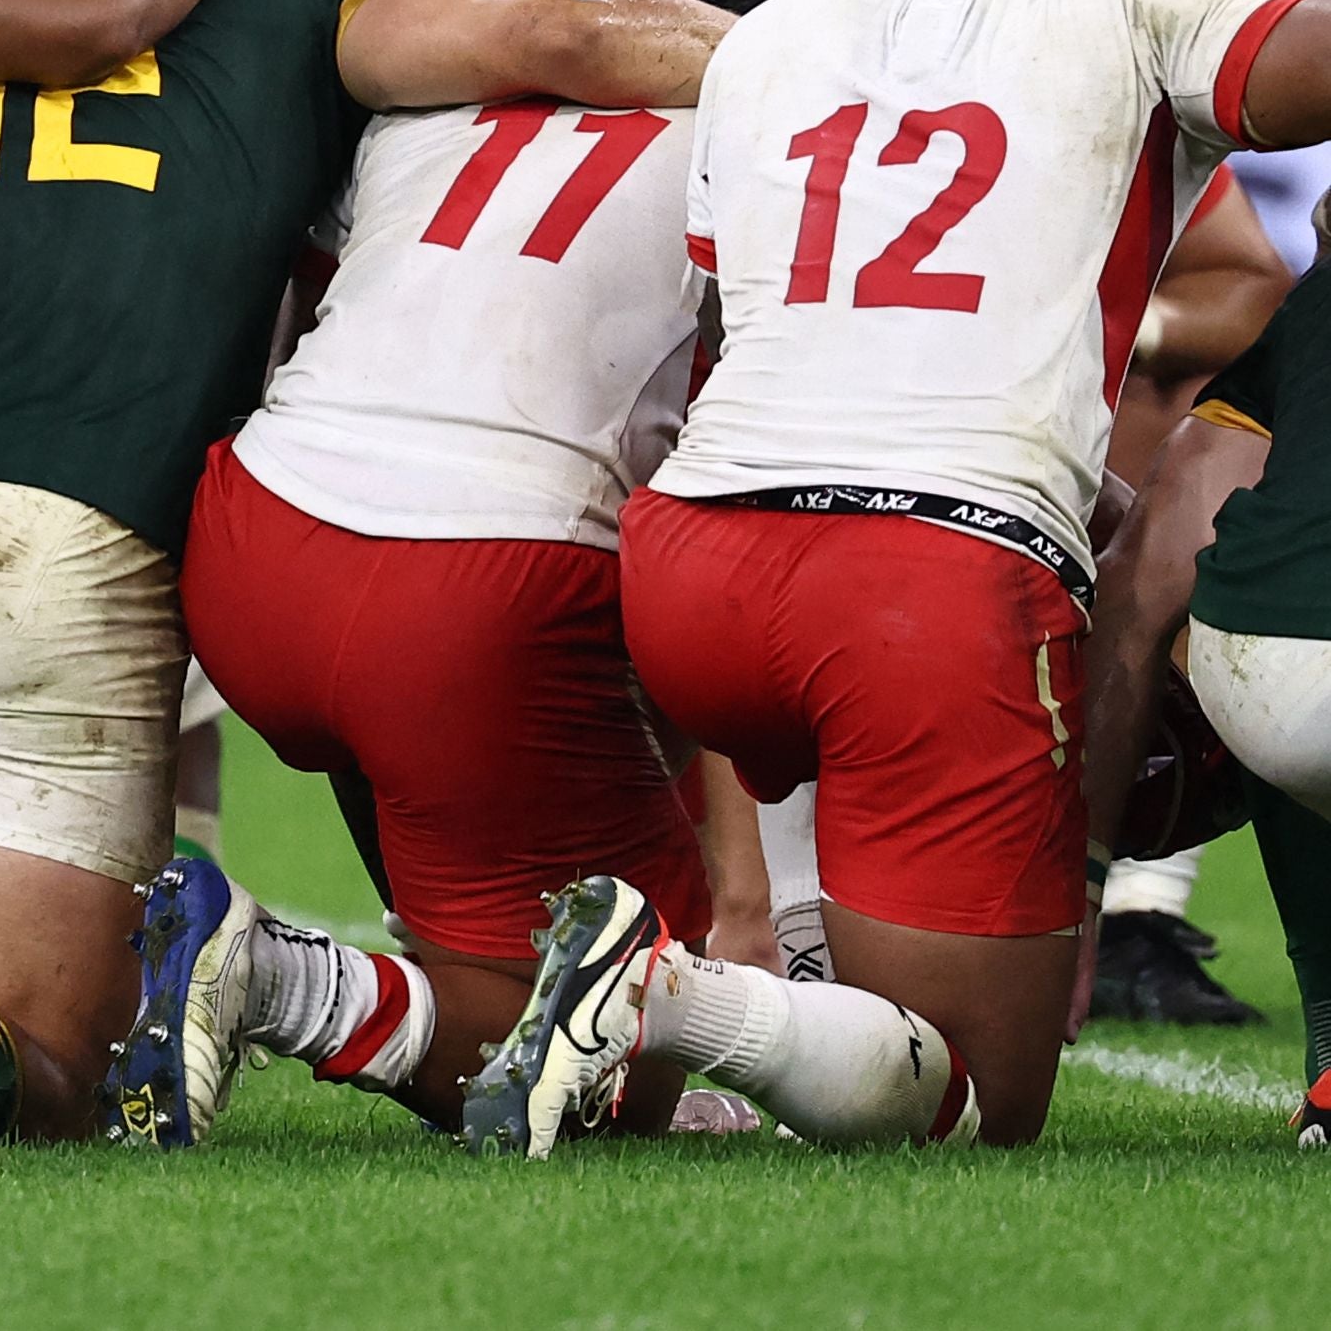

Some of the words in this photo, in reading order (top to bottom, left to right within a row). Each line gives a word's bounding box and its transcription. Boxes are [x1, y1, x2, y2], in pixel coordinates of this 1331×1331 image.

[419, 104, 672, 264] 11
[785, 101, 1008, 314] 12
[790, 491, 835, 510] FXV
